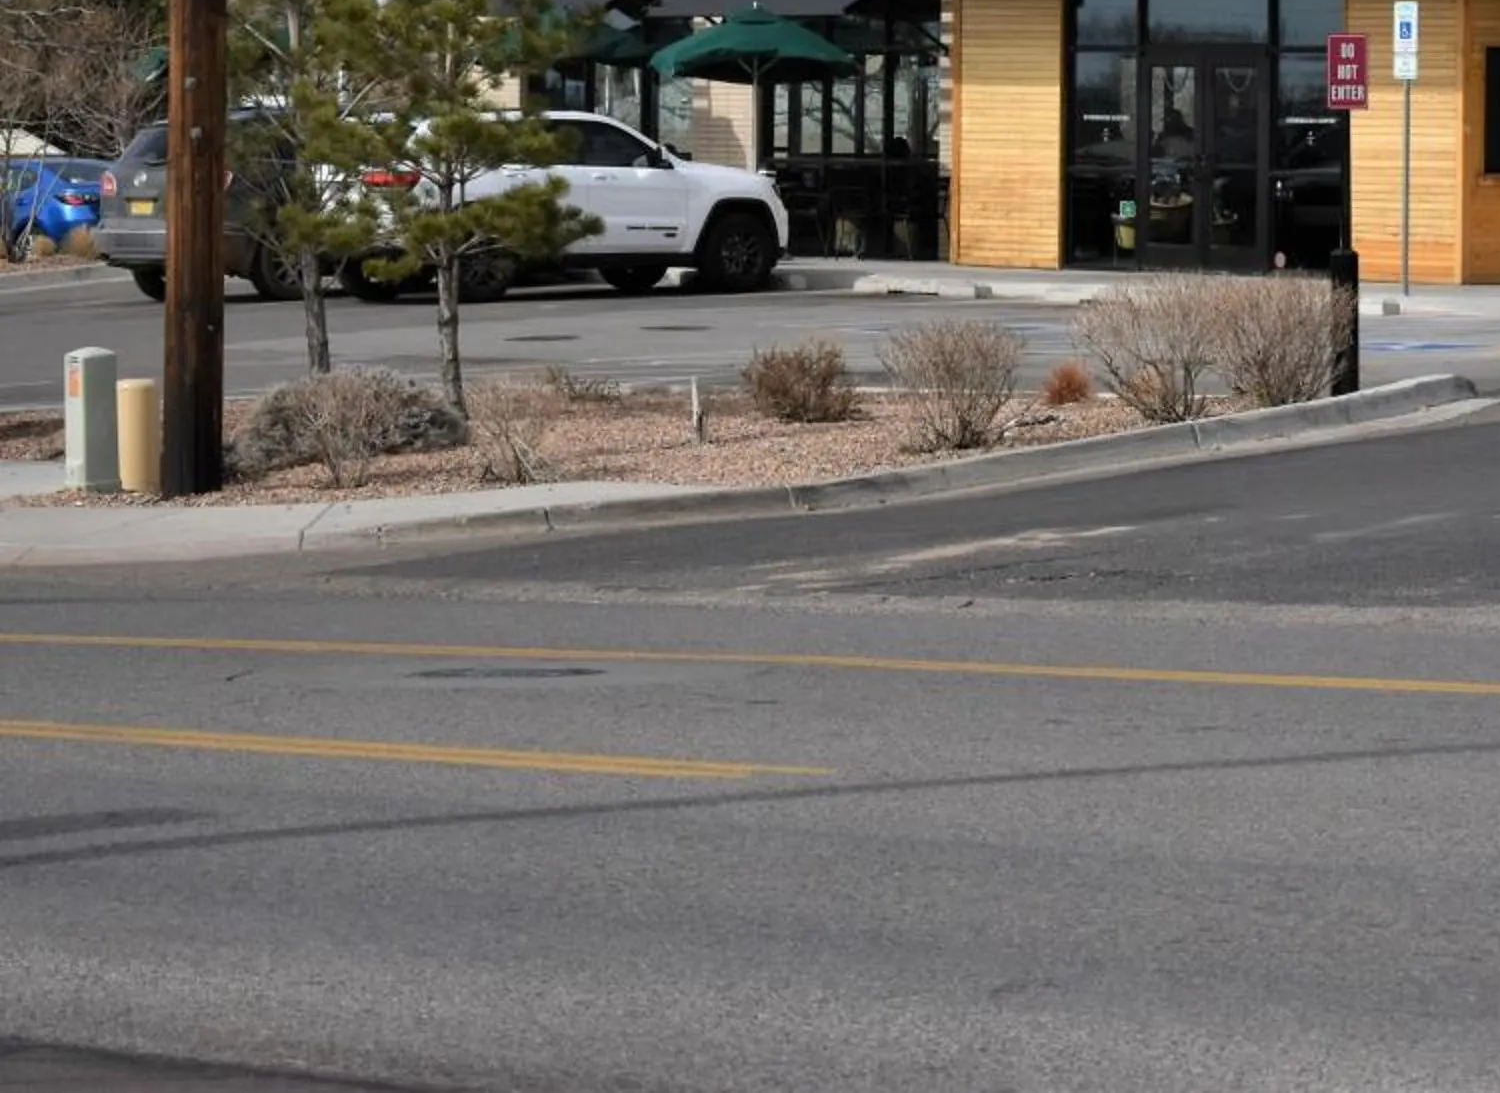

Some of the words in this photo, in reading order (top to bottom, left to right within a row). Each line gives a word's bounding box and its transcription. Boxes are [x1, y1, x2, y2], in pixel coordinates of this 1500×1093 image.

[1340, 42, 1355, 58] DO
[1337, 64, 1359, 80] NOT
[1331, 85, 1365, 101] ENTER
